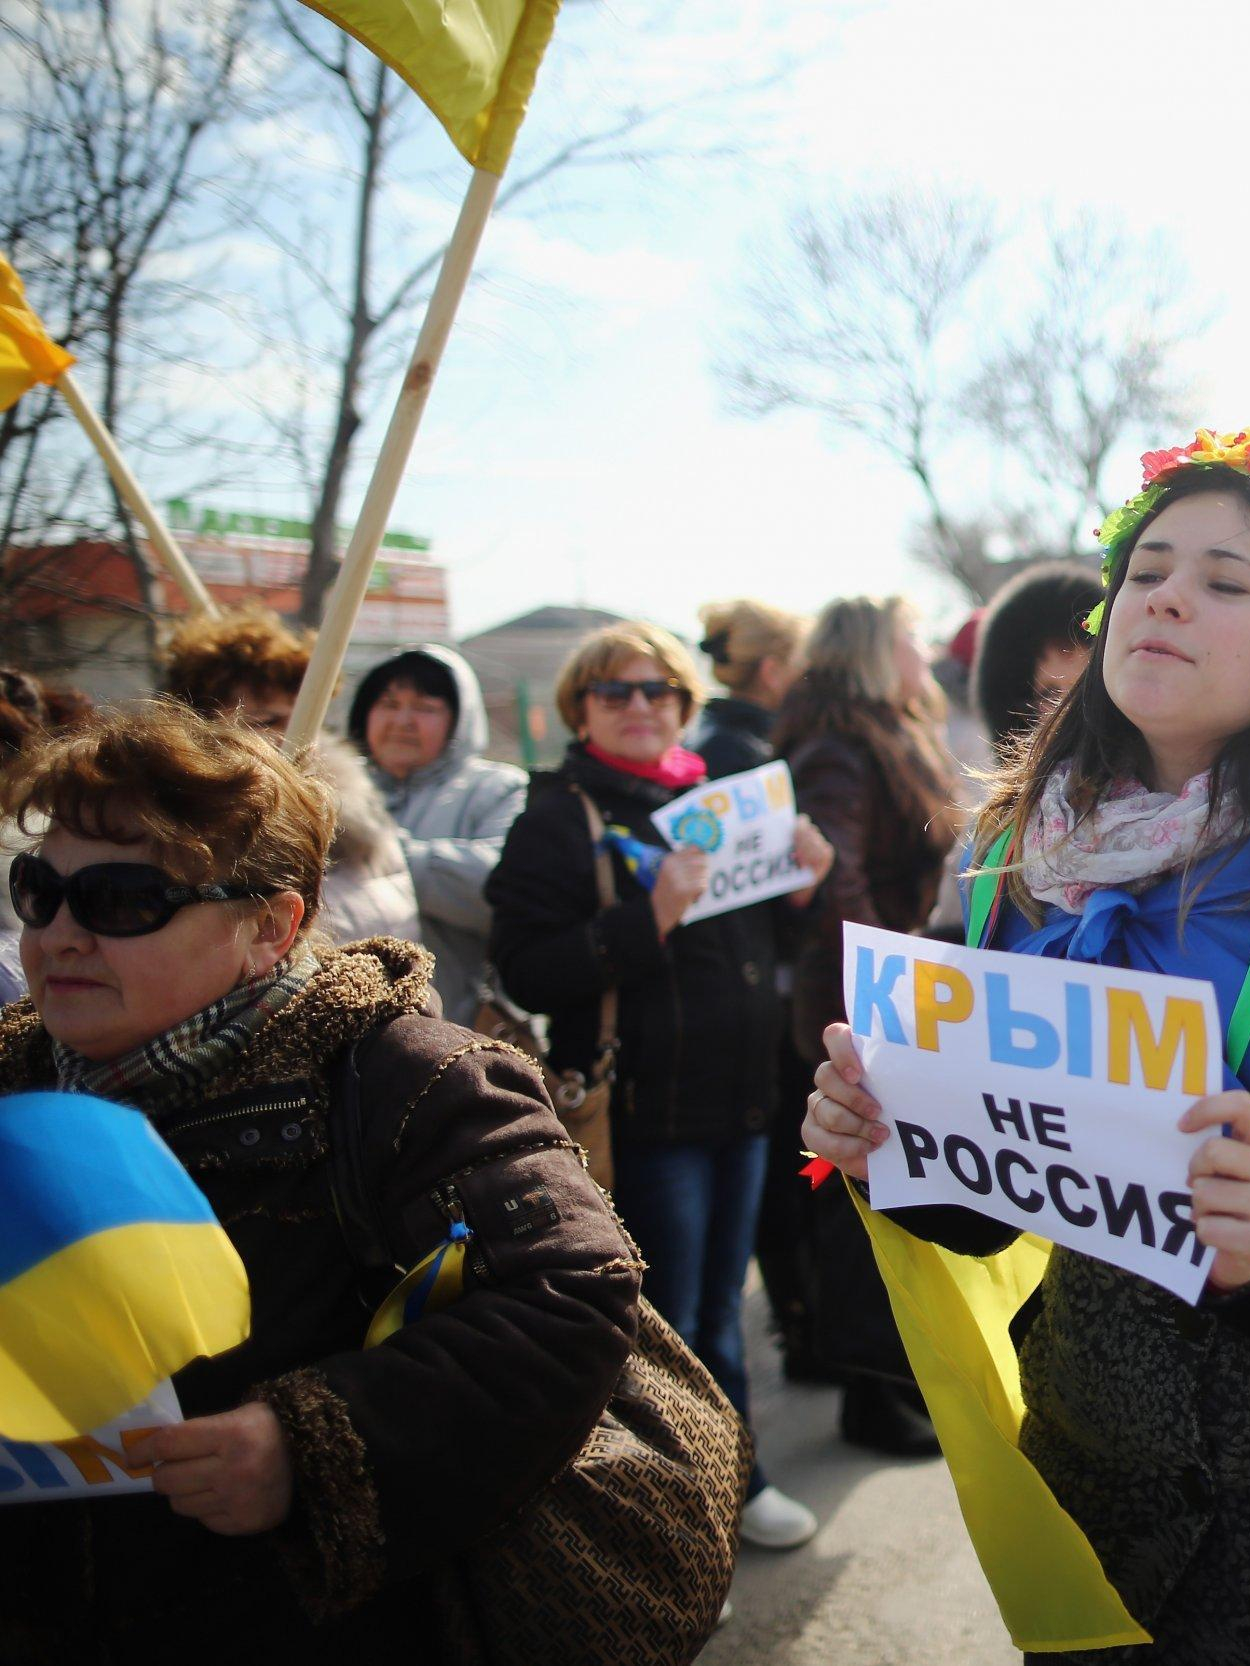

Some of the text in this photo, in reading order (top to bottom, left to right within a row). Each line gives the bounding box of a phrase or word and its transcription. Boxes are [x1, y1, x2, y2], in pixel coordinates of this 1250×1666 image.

[701, 772, 790, 822] РЫМ
[851, 945, 1208, 1096] КРЫМ
[982, 1092, 1072, 1152] НЕ
[895, 1119, 1206, 1268] РОССИЯ
